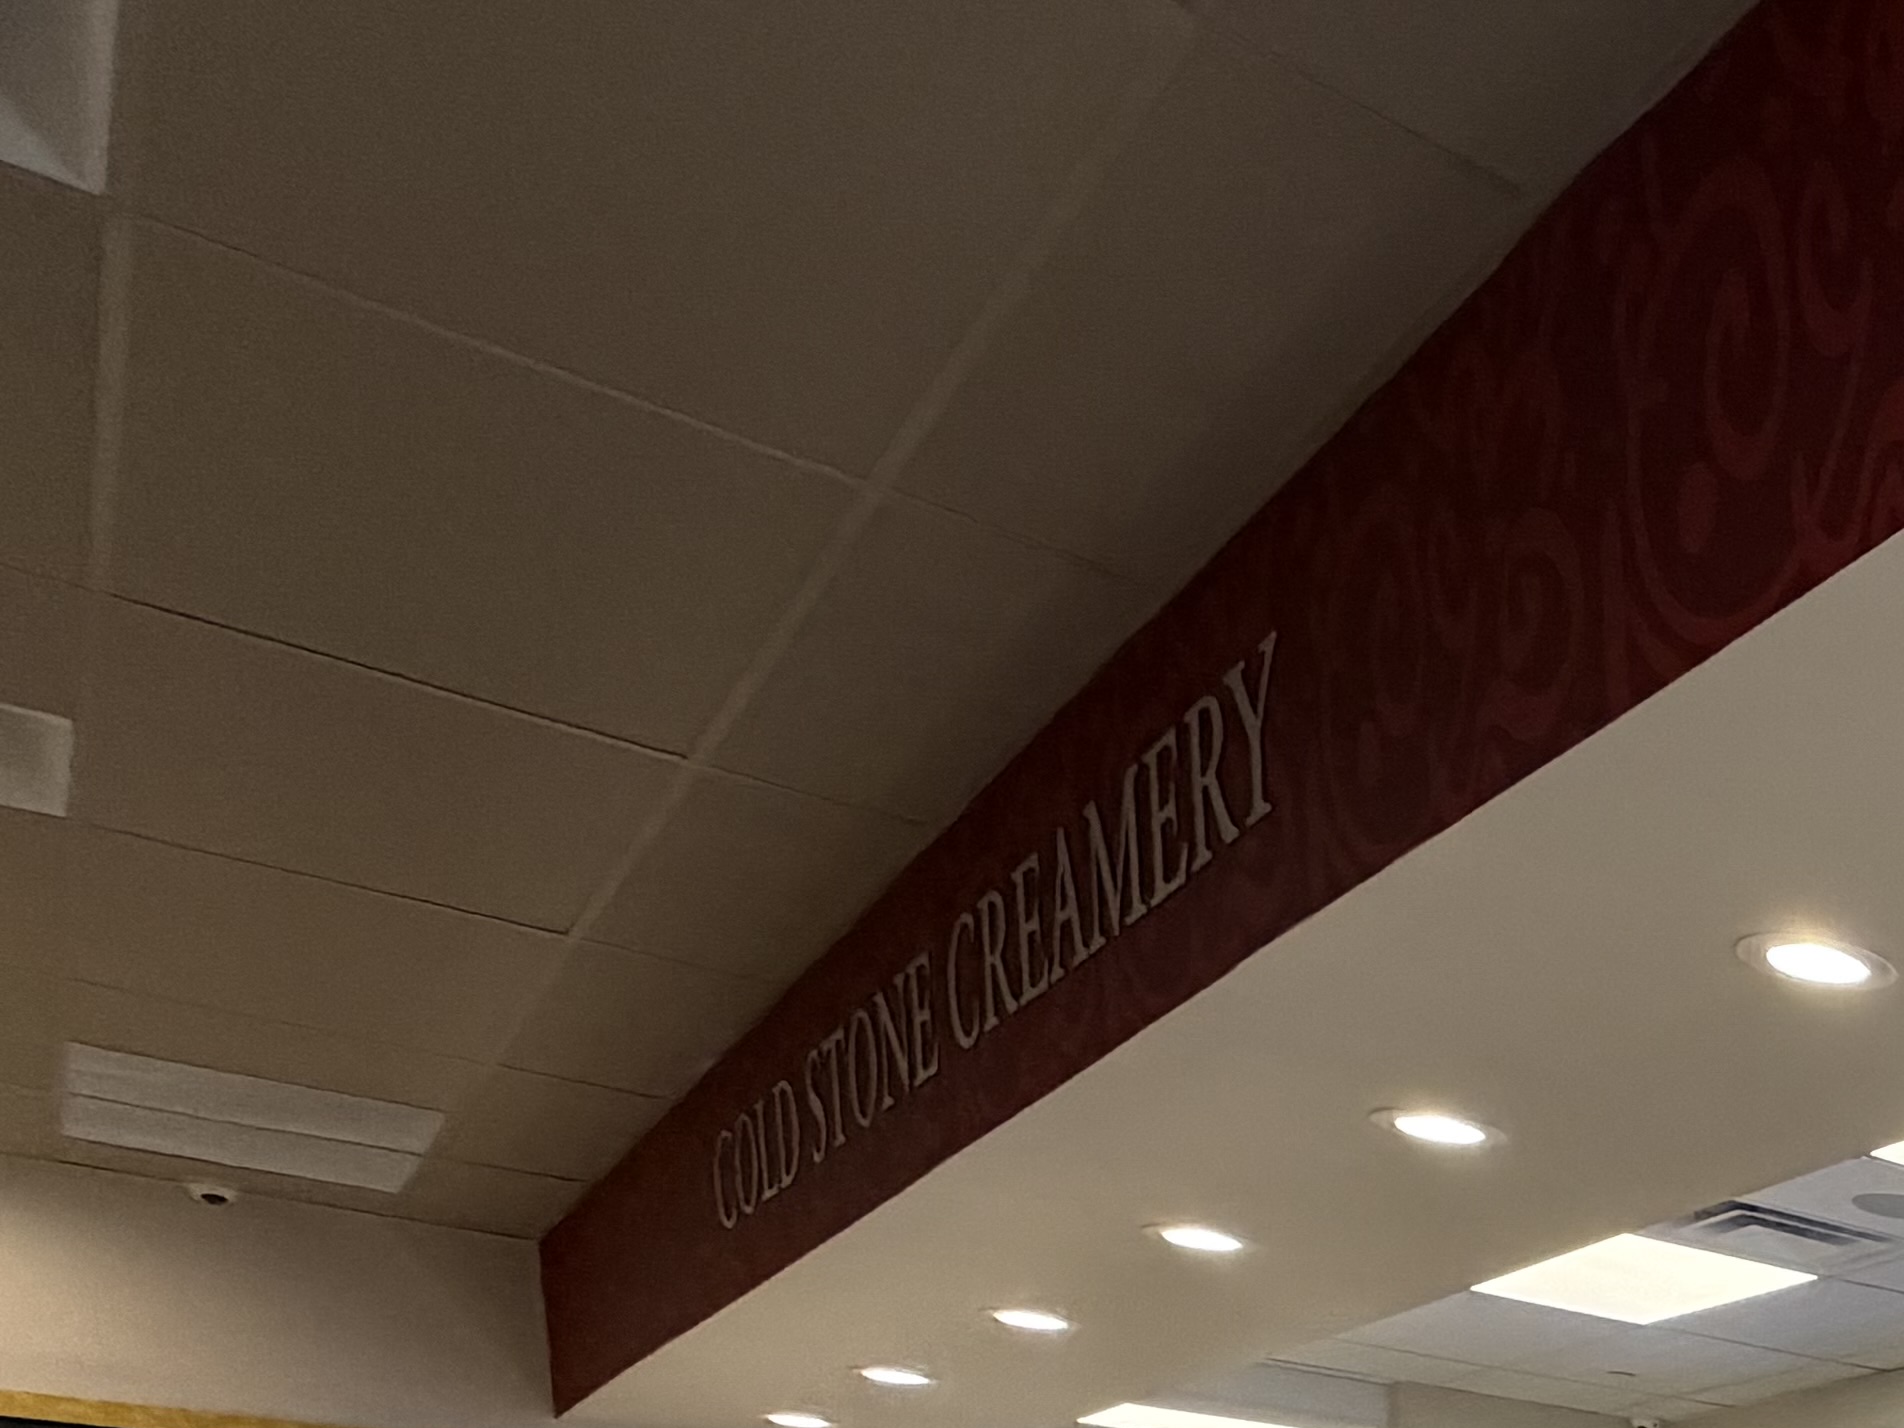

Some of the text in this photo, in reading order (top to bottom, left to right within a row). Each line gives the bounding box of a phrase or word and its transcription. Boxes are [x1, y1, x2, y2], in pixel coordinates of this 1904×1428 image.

[713, 631, 1277, 1229] COLD STONE CREAMERY
